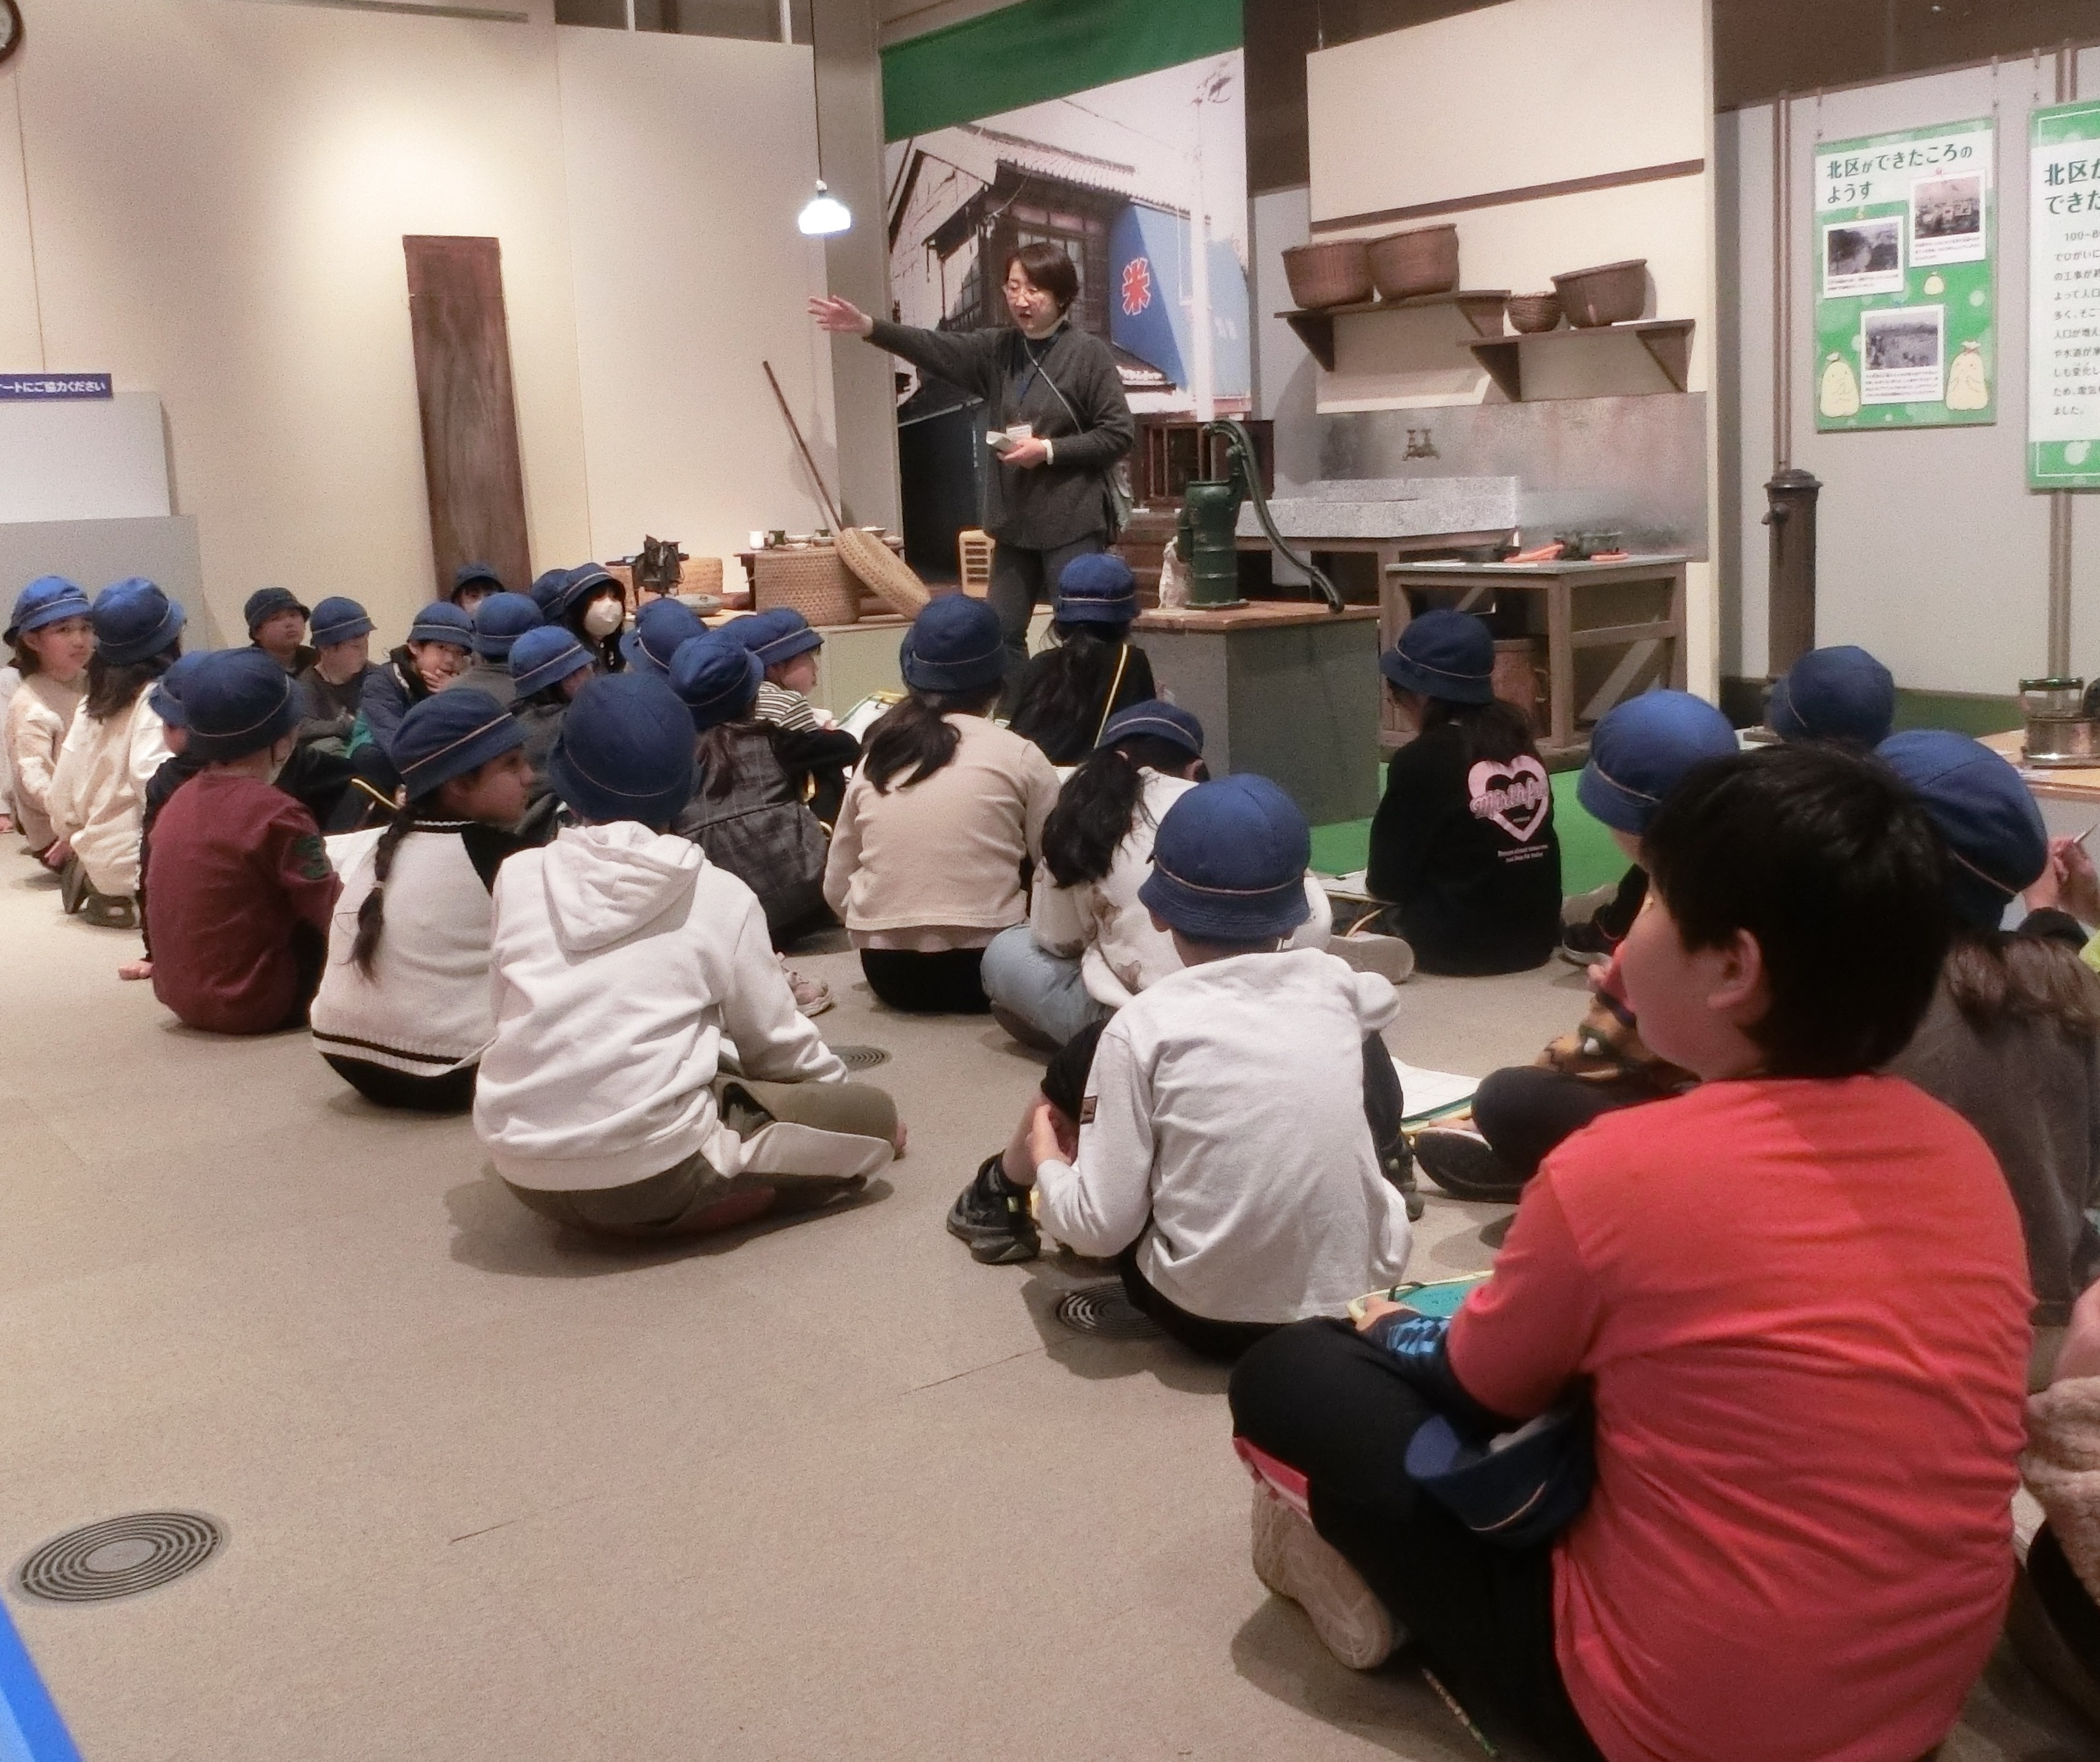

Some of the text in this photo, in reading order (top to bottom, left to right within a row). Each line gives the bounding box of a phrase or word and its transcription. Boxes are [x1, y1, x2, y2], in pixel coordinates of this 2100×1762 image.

[1827, 144, 1973, 179] 北区ができたころの
[1827, 181, 1873, 204] ようす
[0, 381, 106, 393] ートにご協力ください
